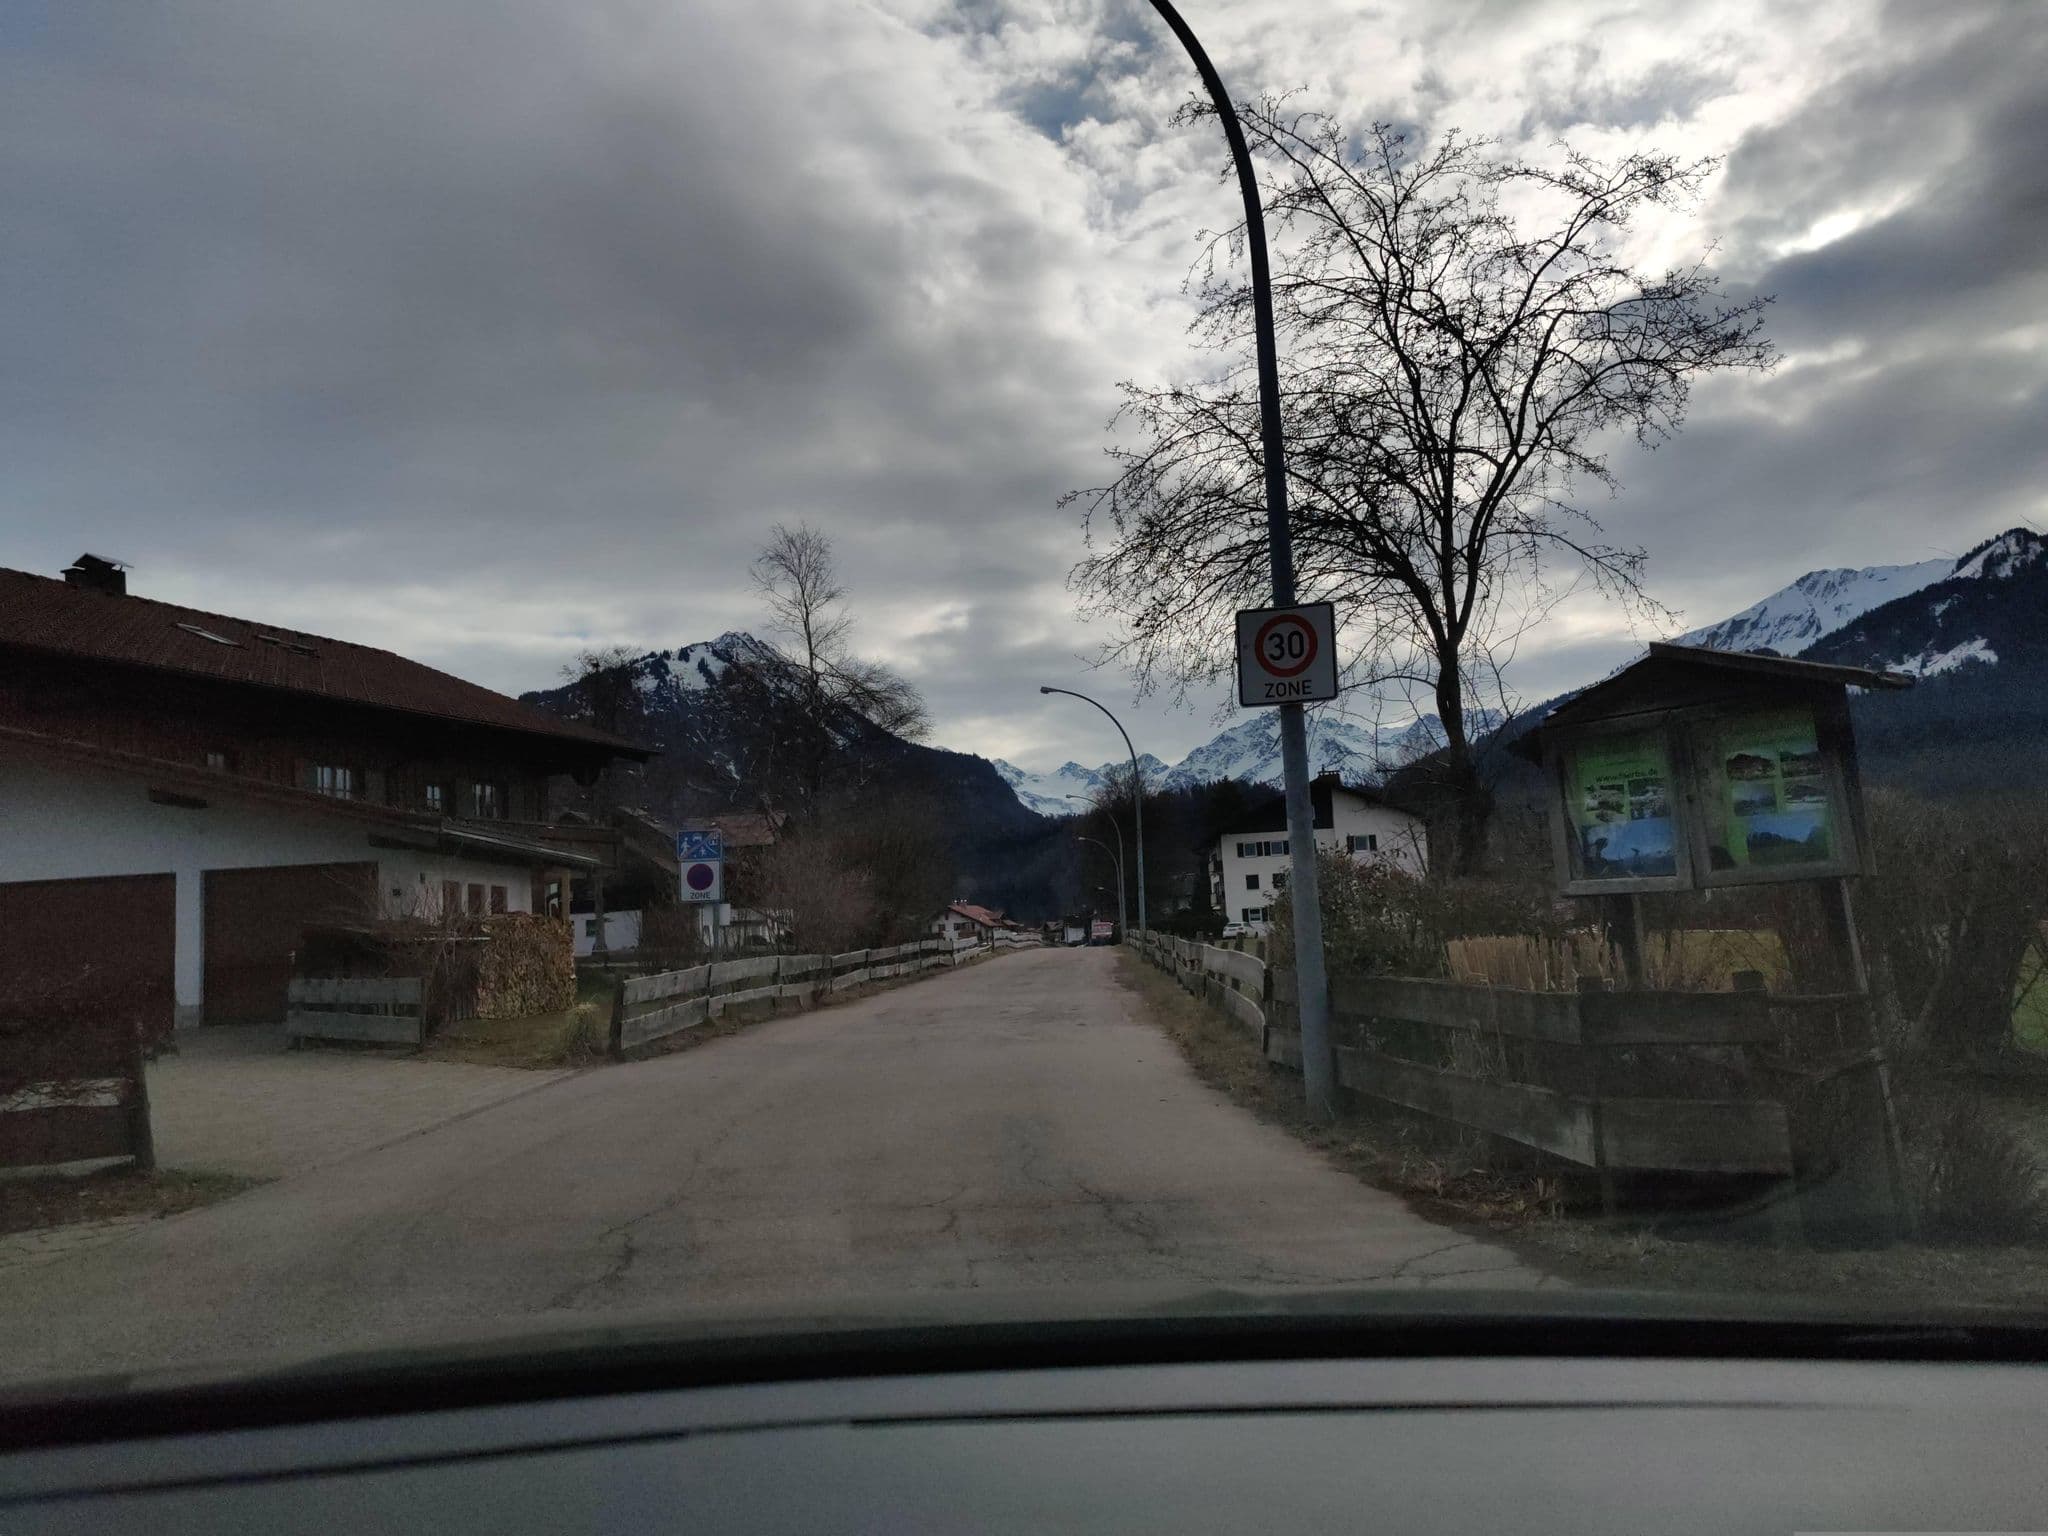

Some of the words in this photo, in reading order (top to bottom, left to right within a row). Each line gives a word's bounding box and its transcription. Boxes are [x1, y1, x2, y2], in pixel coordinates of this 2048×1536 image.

[1268, 630, 1304, 661] 30
[1264, 680, 1312, 698] ZONE
[690, 892, 711, 900] ZONE
